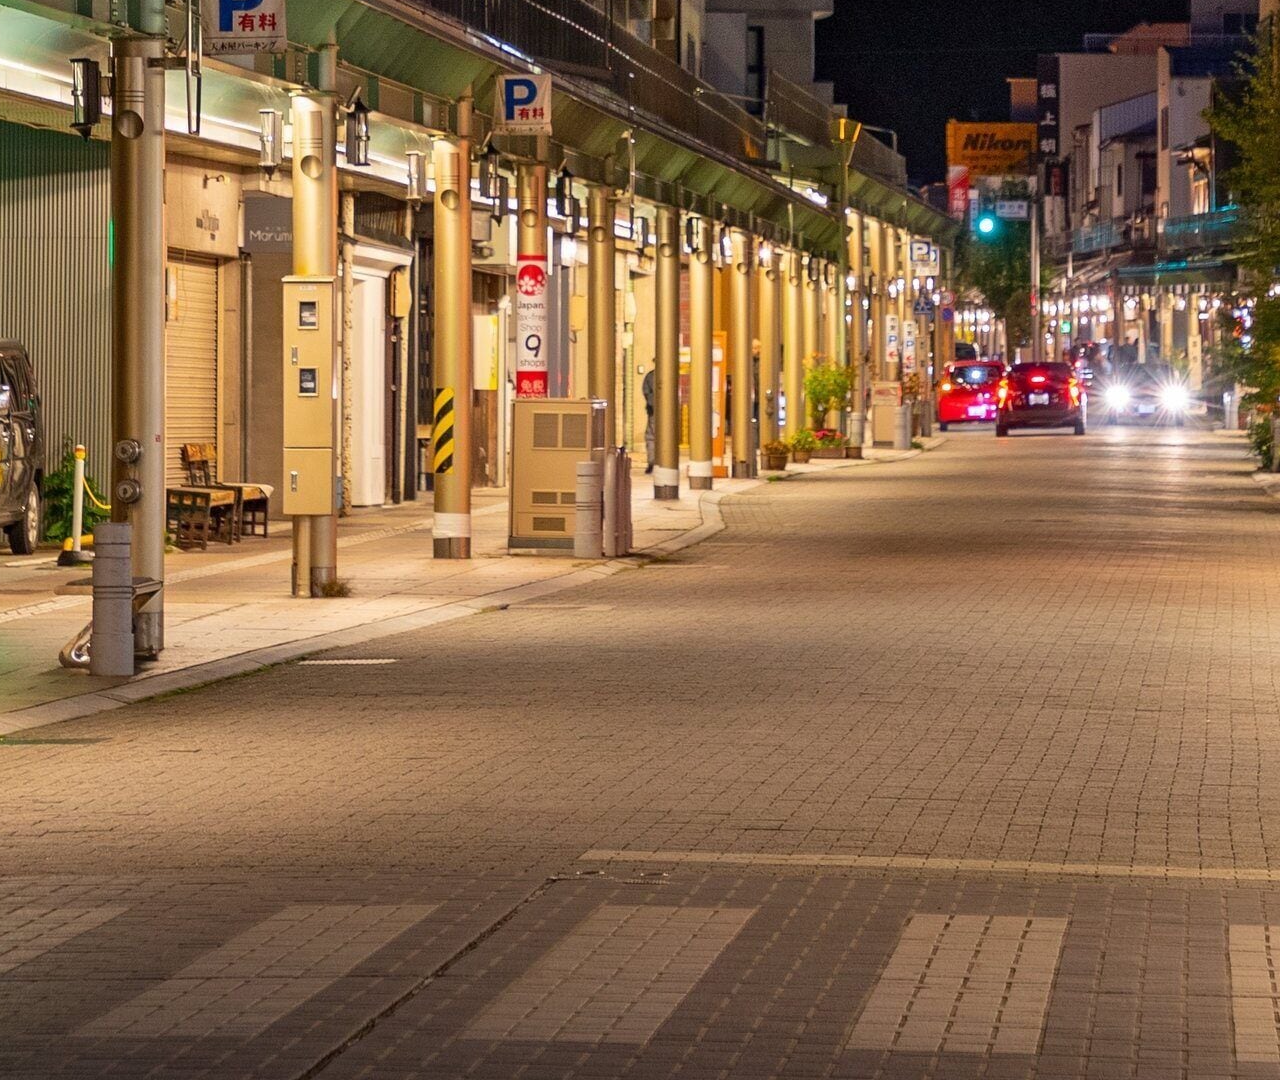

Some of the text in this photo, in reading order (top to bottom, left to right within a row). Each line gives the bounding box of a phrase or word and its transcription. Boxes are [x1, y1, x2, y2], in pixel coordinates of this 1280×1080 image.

[238, 12, 277, 32] 有料
[504, 78, 537, 120] P
[963, 132, 1032, 152] Nikon
[525, 334, 541, 358] 9
